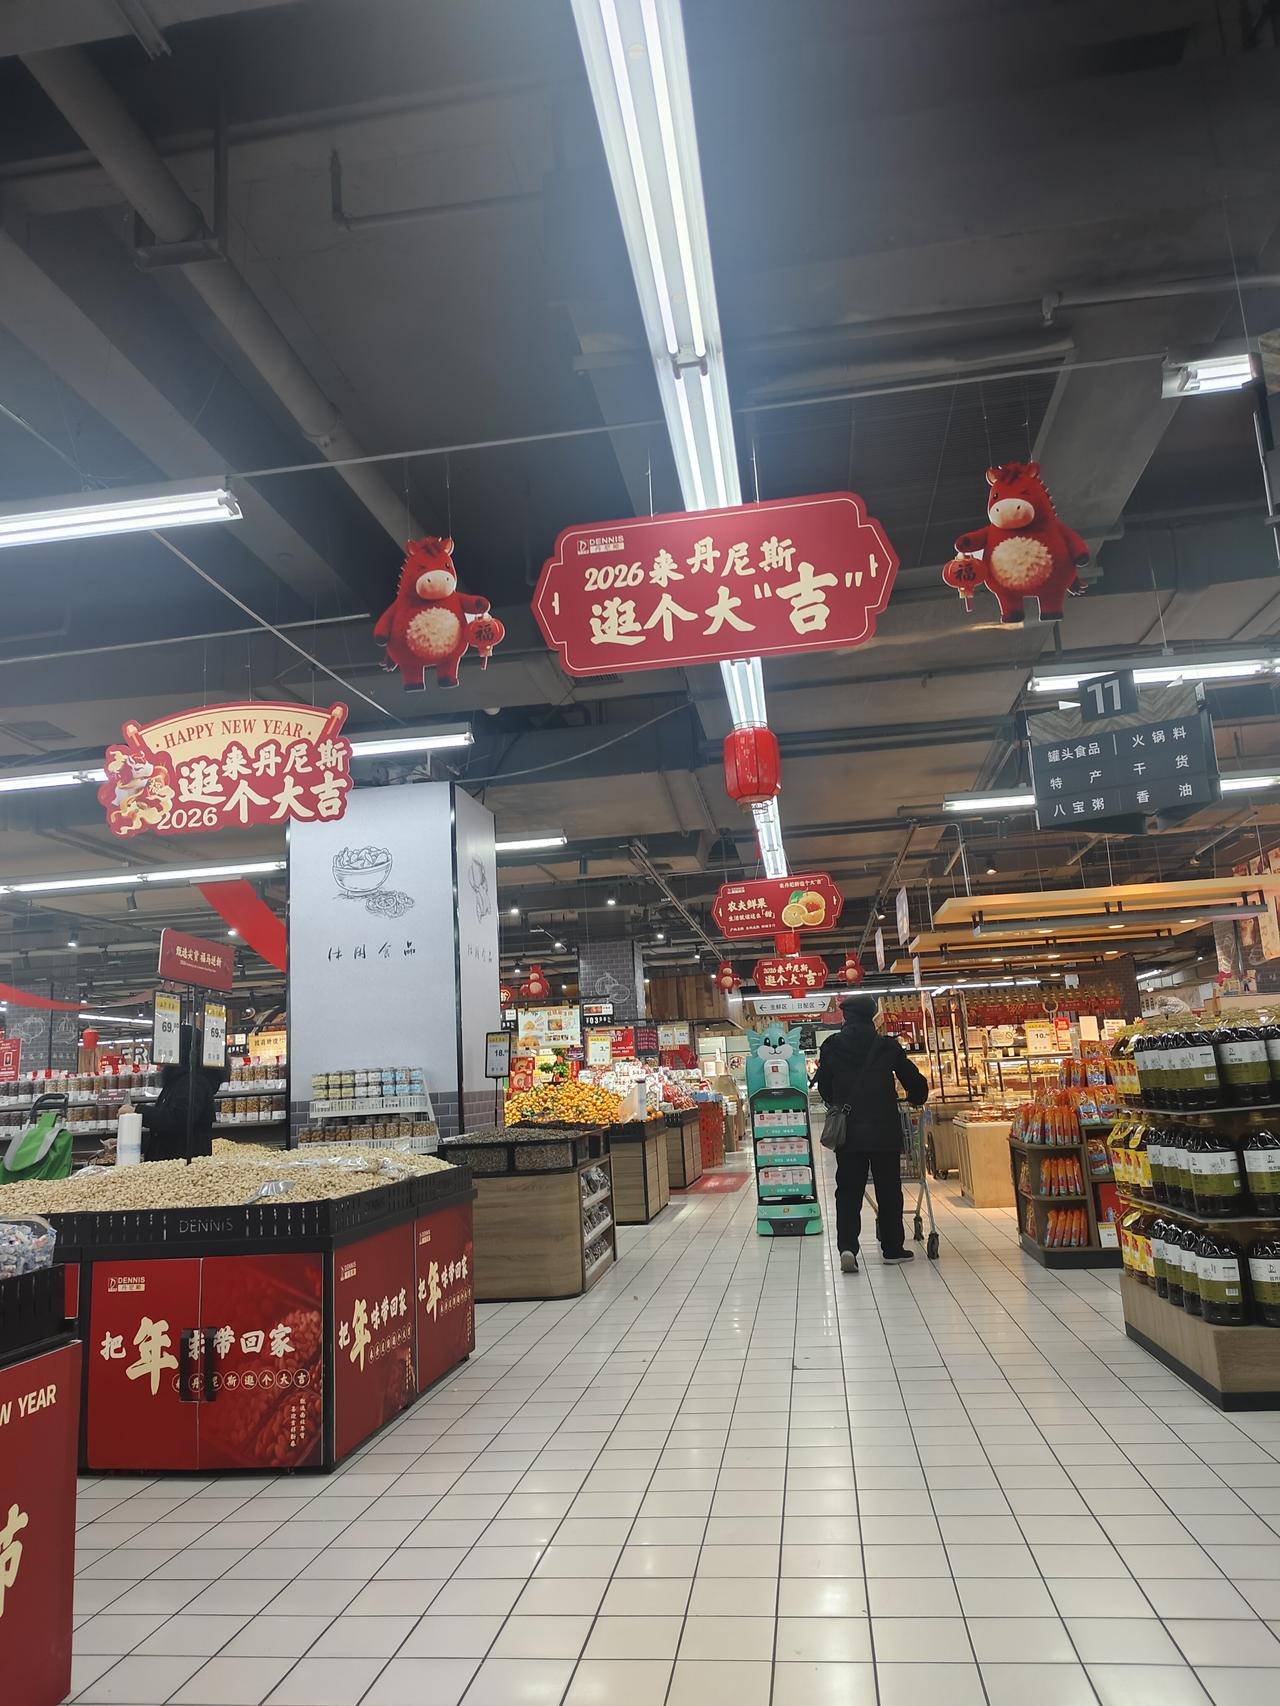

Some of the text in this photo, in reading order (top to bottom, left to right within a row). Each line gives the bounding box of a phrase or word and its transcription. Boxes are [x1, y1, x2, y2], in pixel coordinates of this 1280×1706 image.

[589, 535, 624, 545] DENNIS
[475, 624, 494, 641] 福
[1086, 679, 1122, 714] 11
[163, 719, 304, 749] HAPPY NEW YEAR
[1047, 726, 1187, 763] 罐头食品 火锅料
[222, 738, 348, 780] 来丹尼斯
[178, 760, 348, 824] 逛个大吉
[156, 807, 218, 830] 2026
[1053, 797, 1105, 817] 八宝粥
[727, 897, 768, 913] 农夫鲜果
[179, 1219, 233, 1233] DENNIS
[118, 1276, 145, 1284] DENNIS
[338, 1287, 408, 1373] 把年味带回家
[18, 1383, 57, 1418] YEAR
